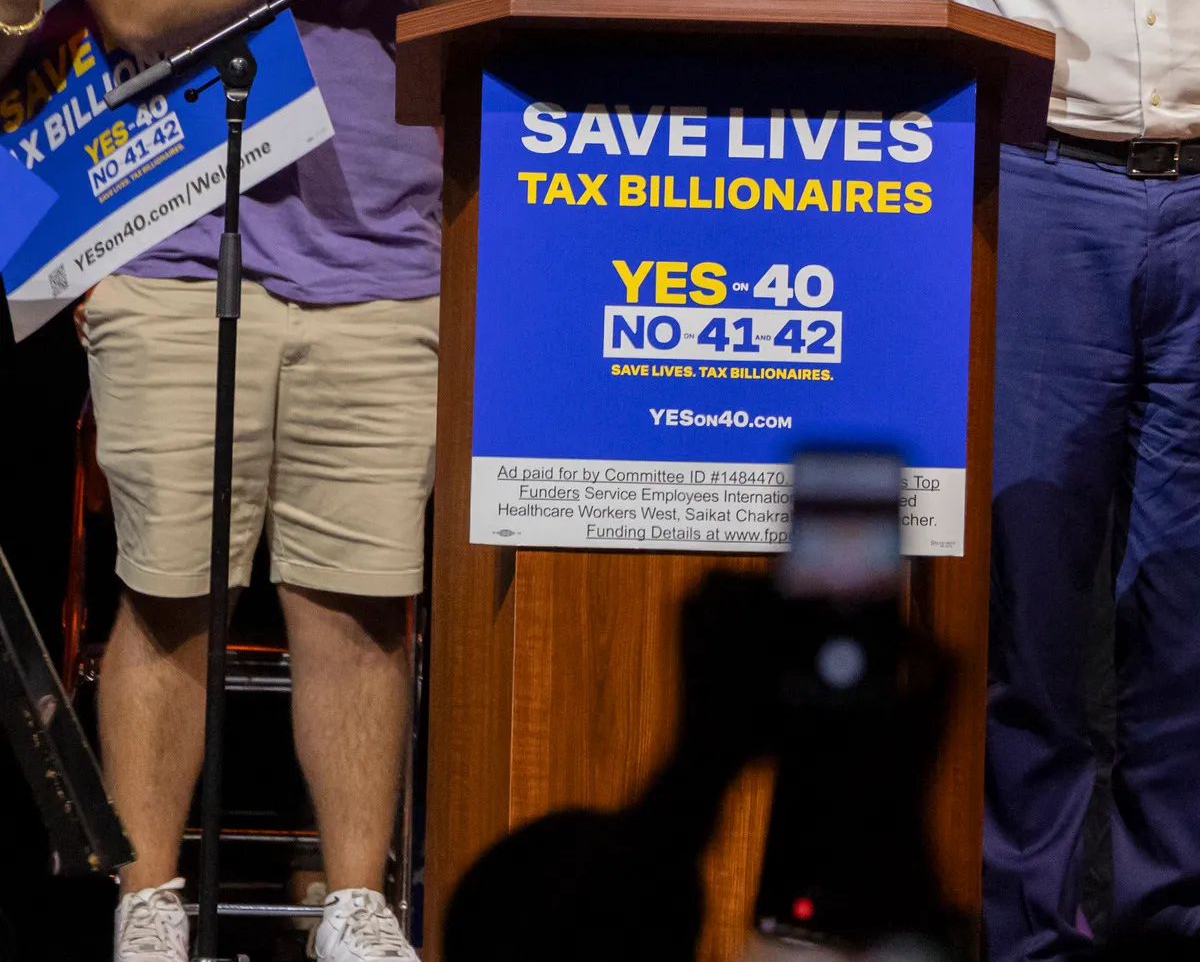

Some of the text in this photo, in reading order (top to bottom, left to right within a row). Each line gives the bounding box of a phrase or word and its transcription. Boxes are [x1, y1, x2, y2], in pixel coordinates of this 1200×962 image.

[0, 27, 96, 134] SAVE
[44, 58, 140, 152] BILLIO
[83, 119, 130, 165] YES
[136, 94, 169, 128] 40
[520, 101, 935, 164] SAVE LIVES
[92, 120, 180, 190] NO 41 42
[73, 138, 273, 274] YESon40.com/Welome
[518, 172, 933, 215] TAX BILLIONAIRES
[612, 260, 835, 308] YES ON 40
[611, 314, 837, 355] NO ON 41 AND 42
[611, 364, 835, 382] SAVE LIVES. TAX BILLIONAIRES.
[497, 465, 517, 480] Ad
[523, 466, 553, 483] paid
[559, 467, 578, 481] for
[583, 468, 600, 484] by
[605, 468, 684, 483] Committee
[690, 470, 706, 483] ID
[710, 470, 789, 485] #1484470.
[913, 476, 940, 492] Top
[520, 485, 791, 505] Funders Service Employees Internatio
[498, 503, 937, 527] Healthcare Workers West, Saikat Chakra cher.
[587, 524, 790, 545] Funding Details at www.fpp
